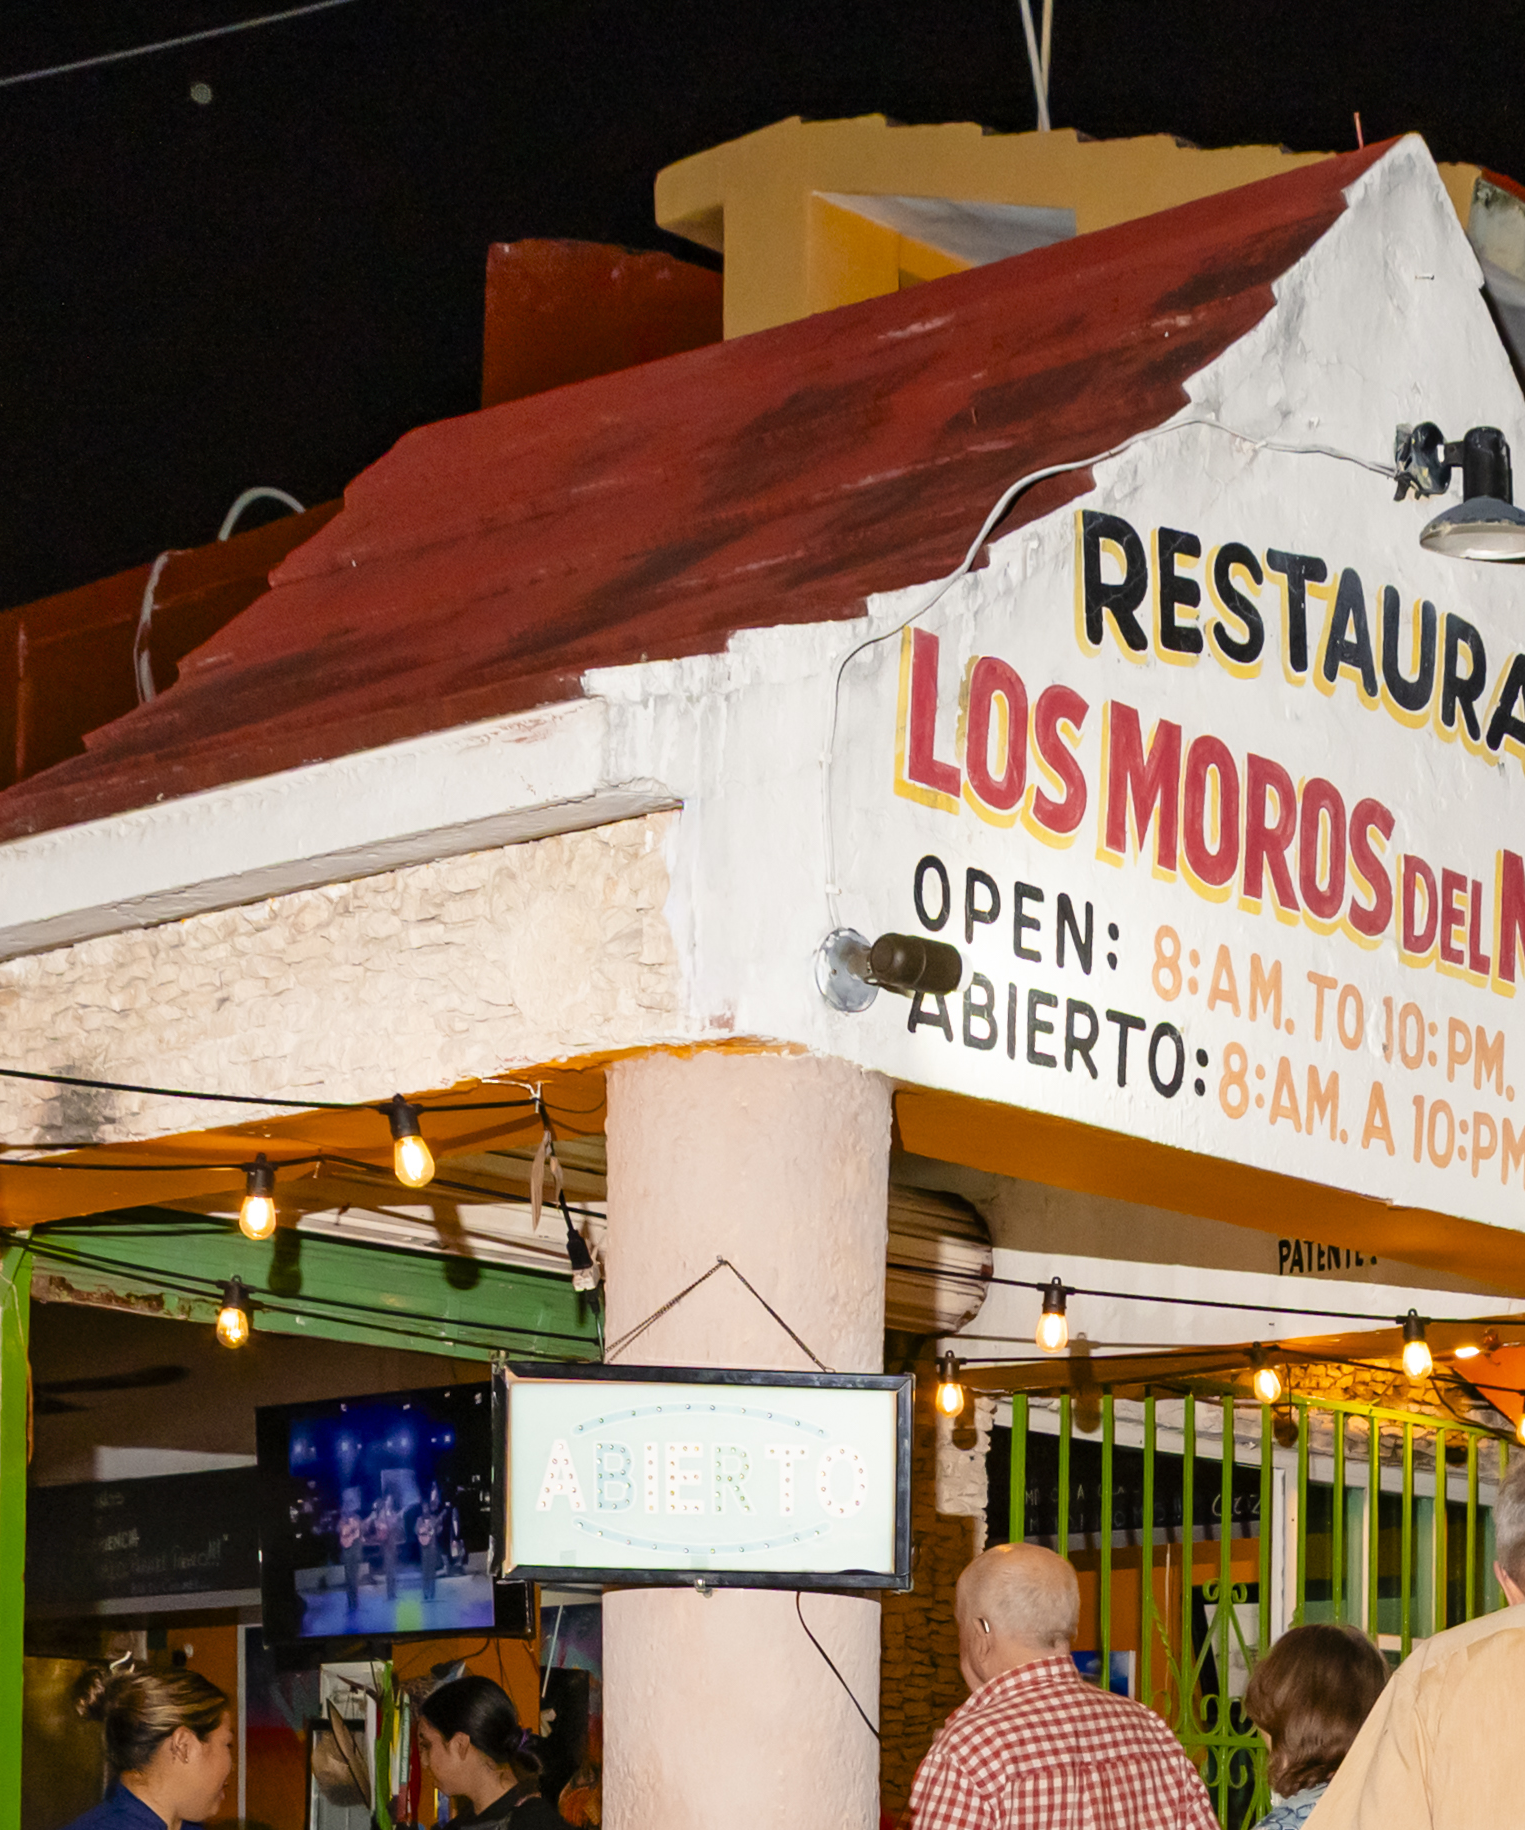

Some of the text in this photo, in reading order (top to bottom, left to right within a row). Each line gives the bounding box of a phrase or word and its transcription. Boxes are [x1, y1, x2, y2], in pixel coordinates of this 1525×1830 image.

[894, 626, 1091, 850] LOS
[1097, 698, 1395, 951] MOROS
[1398, 852, 1491, 988] DEL
[913, 854, 1120, 976] OPEN:
[1307, 970, 1365, 1051] TO
[907, 972, 1210, 1099] ABIERTO:
[1361, 1081, 1395, 1157] A
[535, 1438, 869, 1519] ABIERTO
